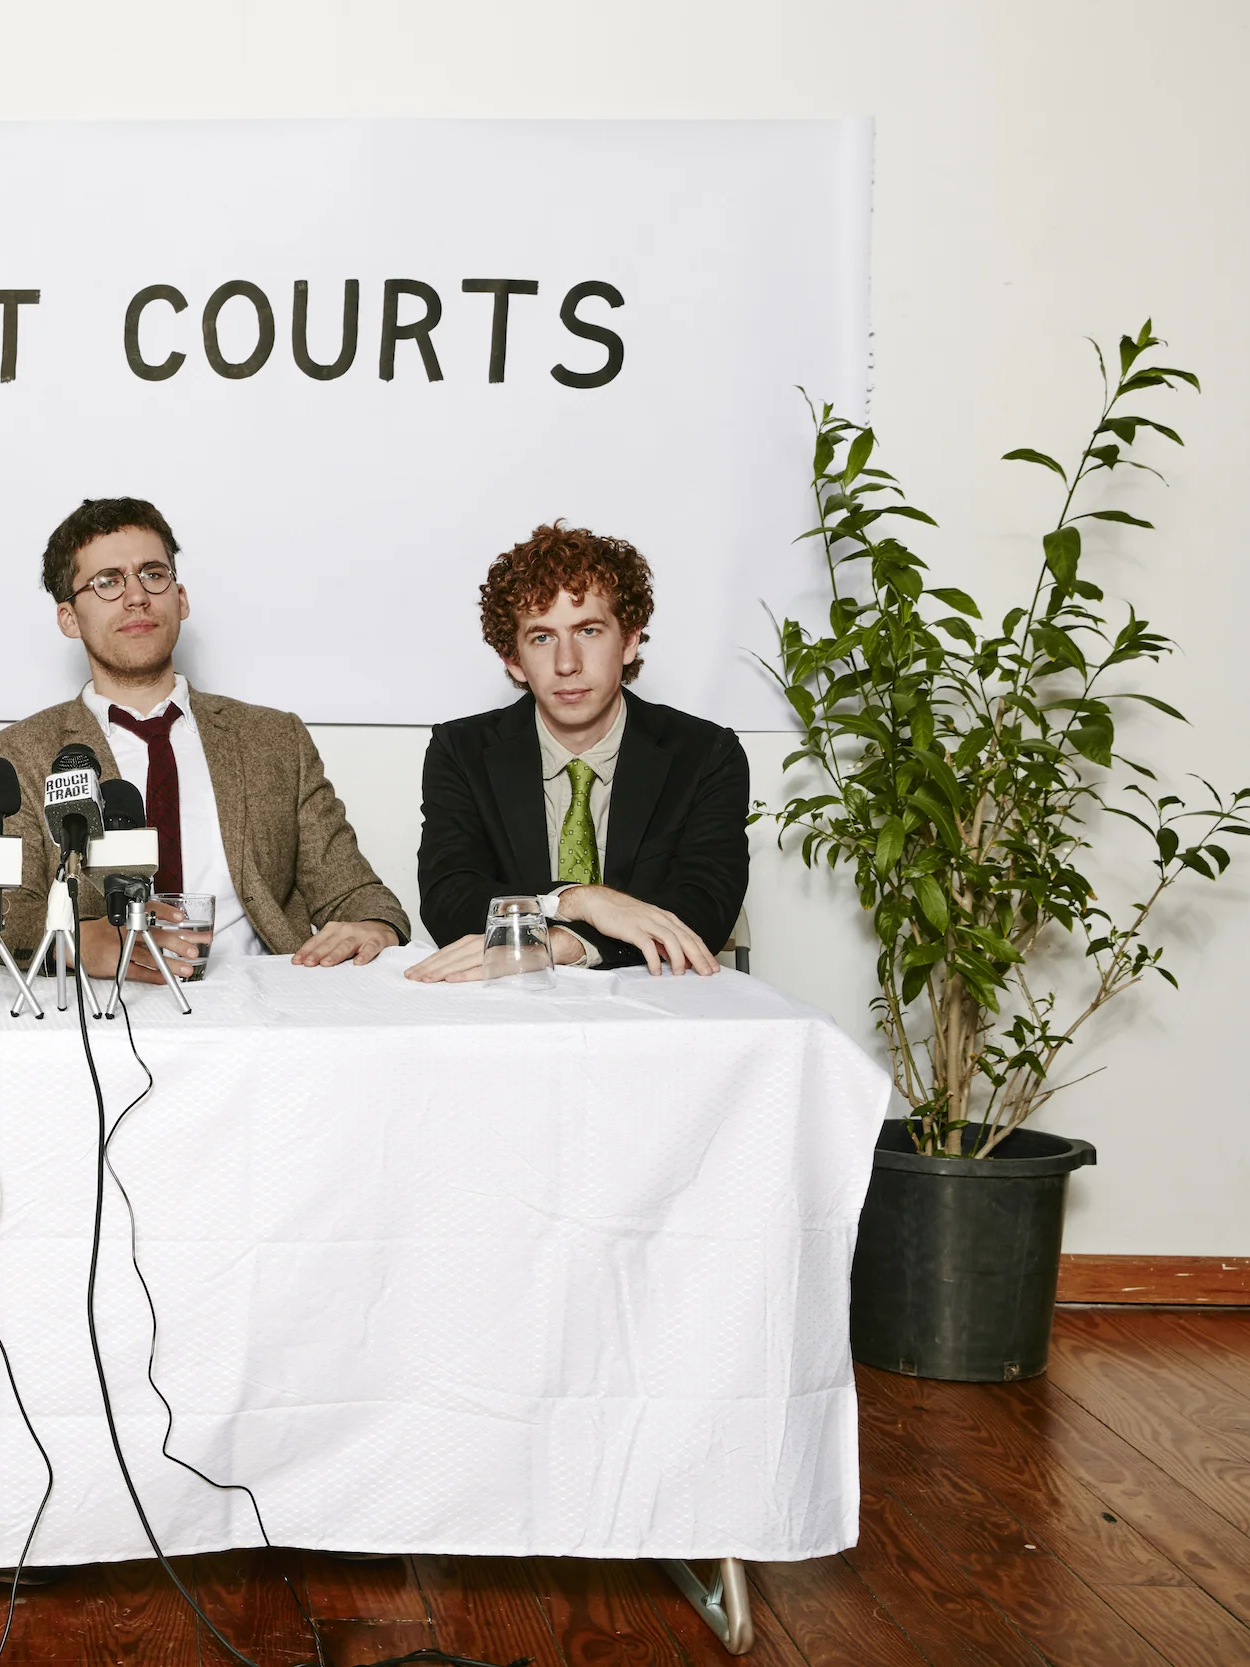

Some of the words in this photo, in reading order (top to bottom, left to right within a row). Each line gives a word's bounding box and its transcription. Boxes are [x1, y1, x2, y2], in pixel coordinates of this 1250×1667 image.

[125, 279, 625, 389] COURTS
[46, 773, 88, 791] ROUGH
[47, 784, 89, 802] TRADE
